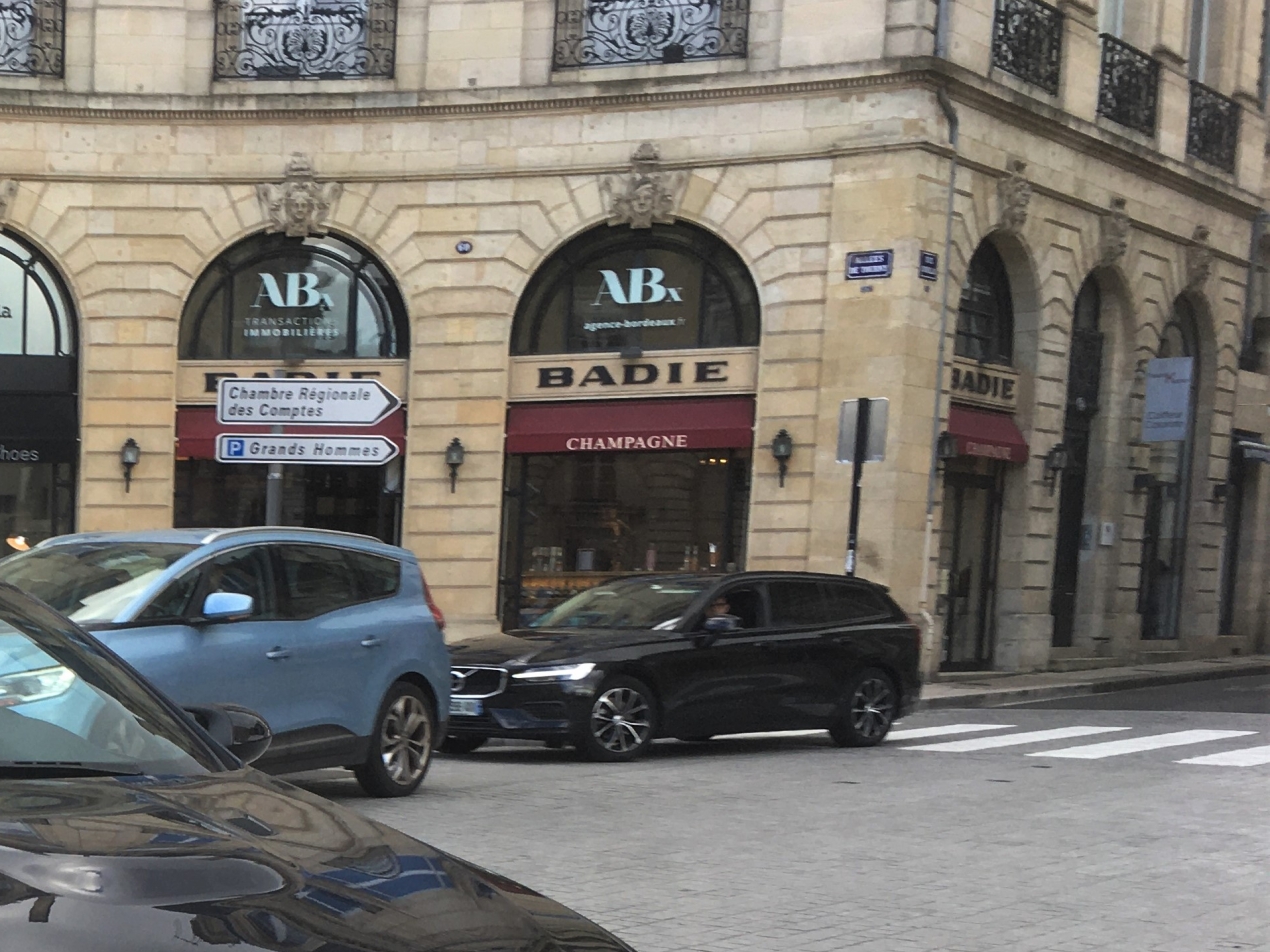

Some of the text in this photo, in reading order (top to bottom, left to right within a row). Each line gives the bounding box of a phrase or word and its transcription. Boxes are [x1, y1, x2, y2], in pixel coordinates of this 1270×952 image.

[244, 326, 340, 337] IMMOBILIÈRES
[537, 361, 729, 389] BADIE
[228, 386, 371, 404] Chambre Régionale
[228, 403, 323, 419] des Comptes
[231, 442, 380, 457] P Grands Hommes
[566, 434, 688, 450] CHAMPAGNE
